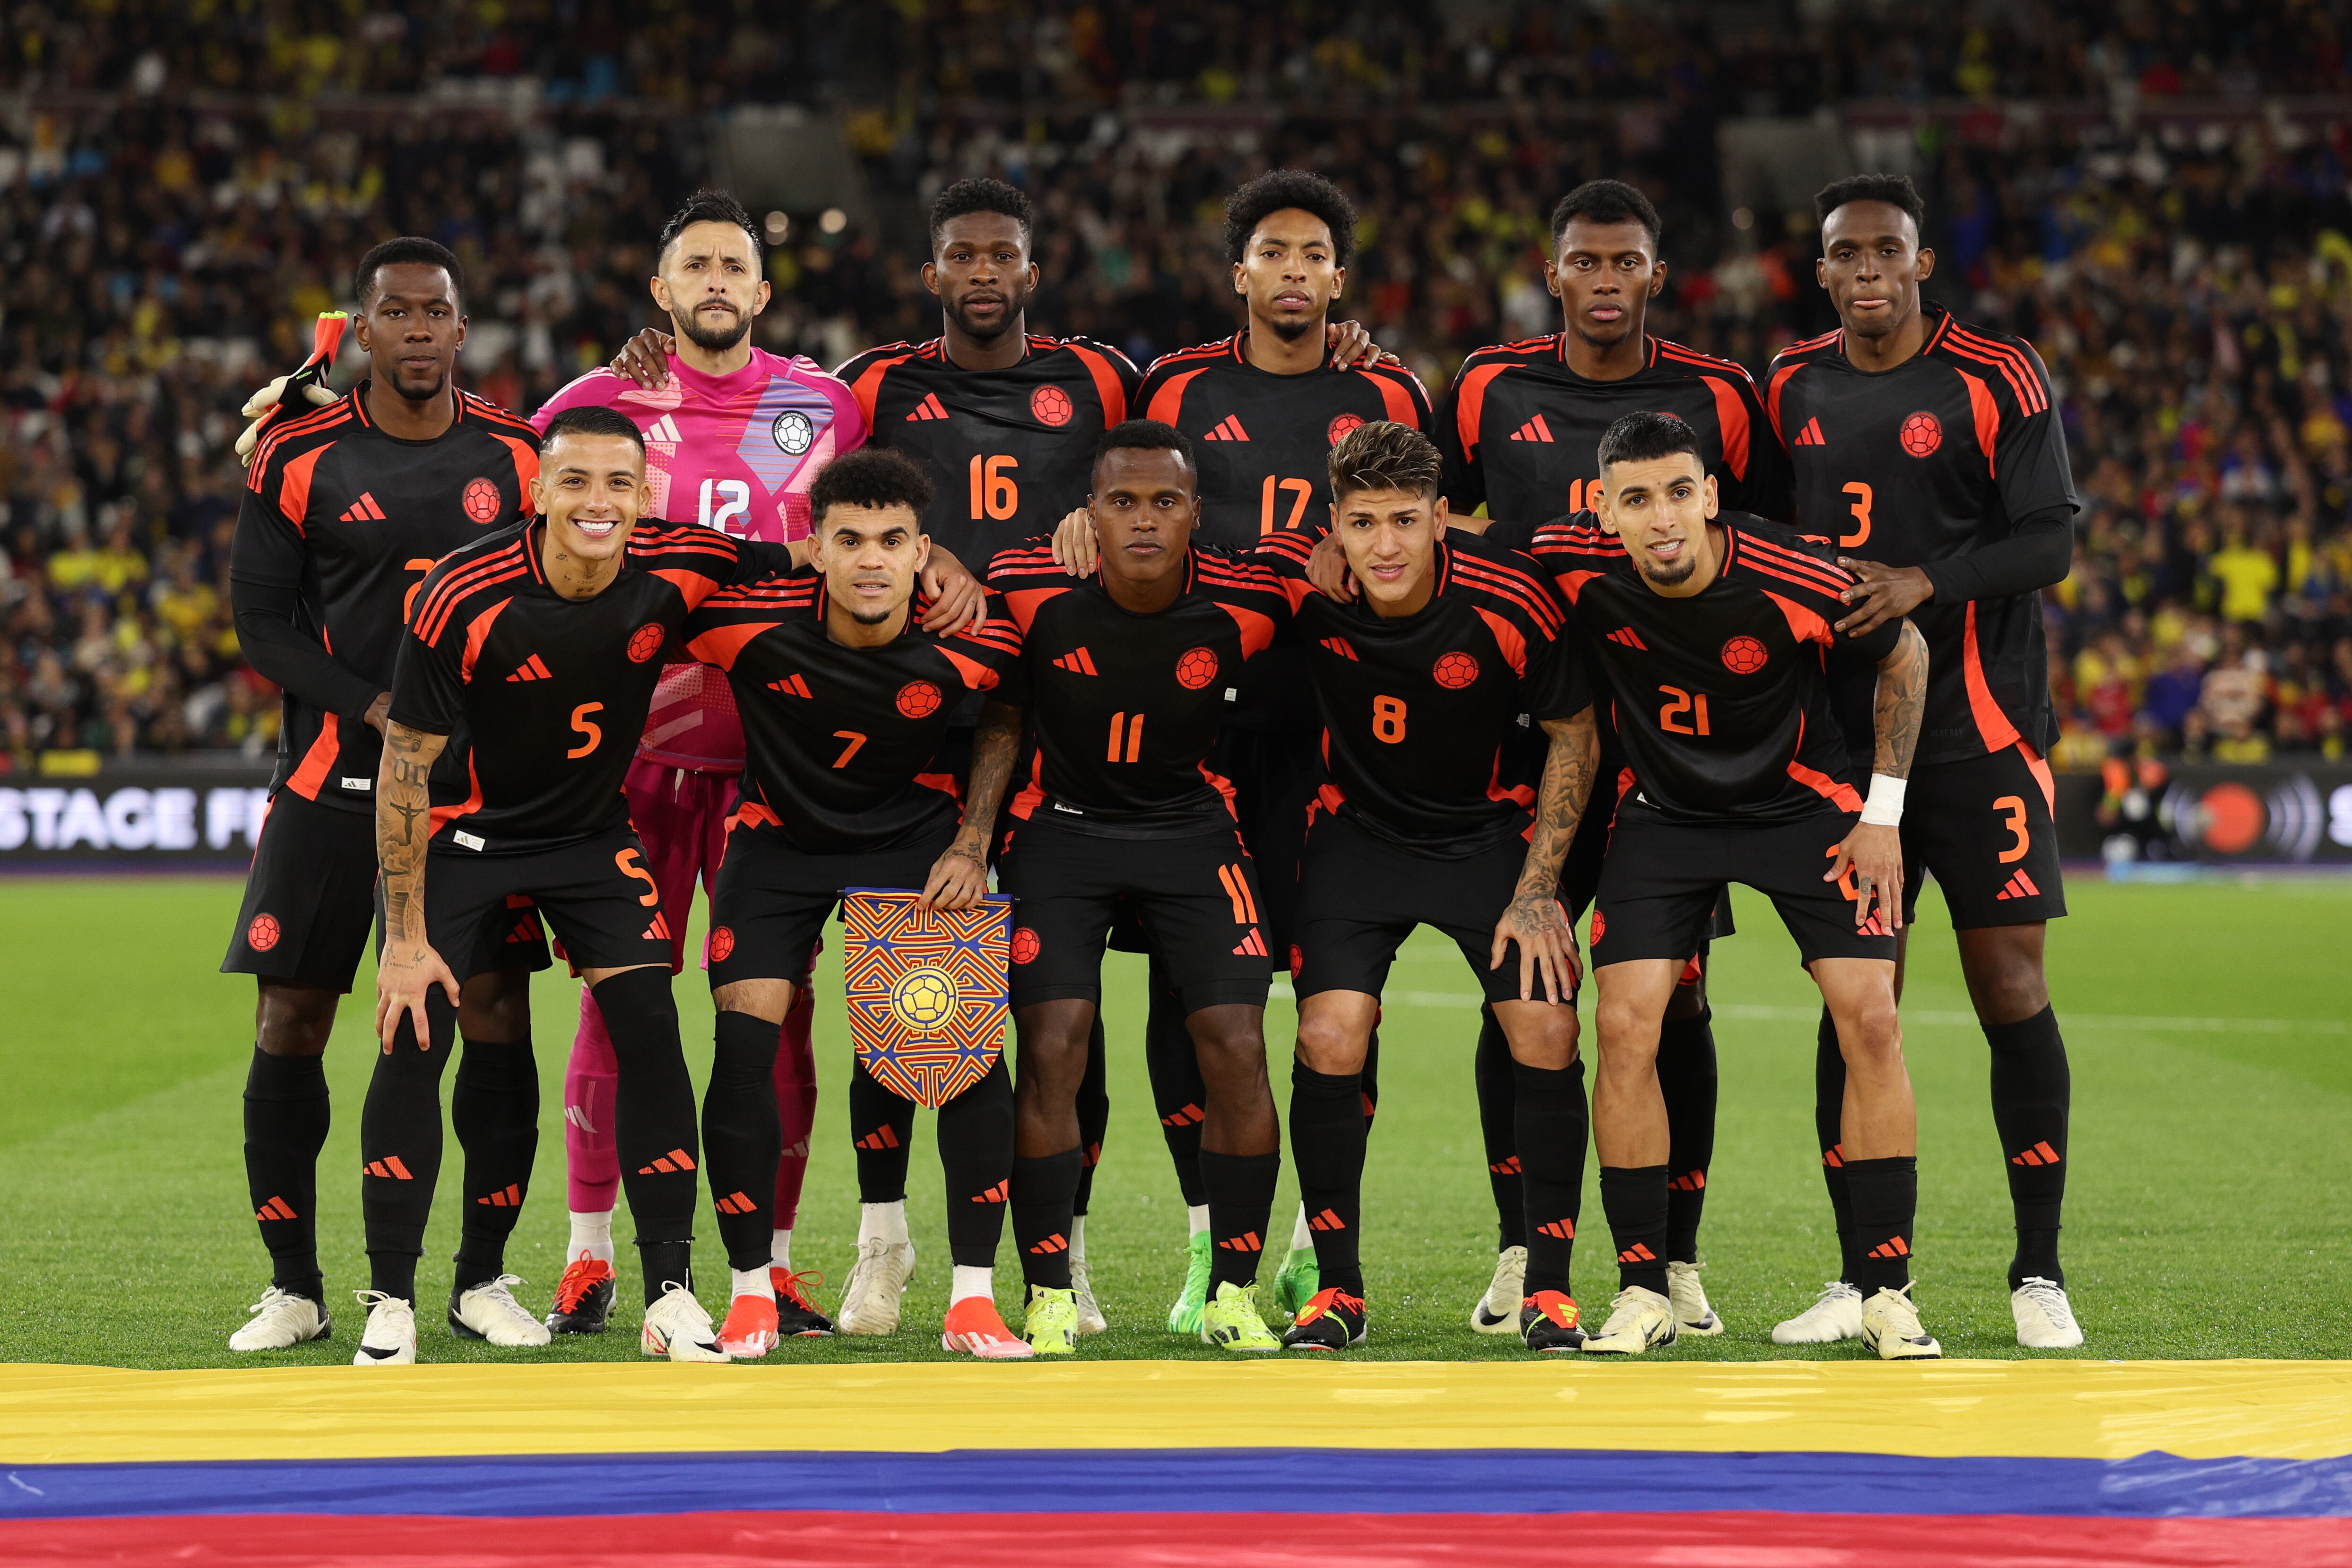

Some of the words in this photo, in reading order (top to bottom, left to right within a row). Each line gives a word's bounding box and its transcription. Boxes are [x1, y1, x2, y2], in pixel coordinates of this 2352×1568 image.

[698, 478, 750, 540] 12
[970, 454, 1018, 520] 16
[1260, 475, 1312, 537] 17
[1839, 481, 1873, 547] 3
[567, 702, 604, 759] 5
[1107, 711, 1144, 762] 11
[1373, 695, 1406, 744] 8
[1659, 685, 1710, 736] 21
[833, 730, 867, 768] 7
[0, 787, 198, 850] STAGE
[1993, 796, 2030, 864] 3
[615, 848, 658, 906] 5
[1218, 864, 1258, 924] 11
